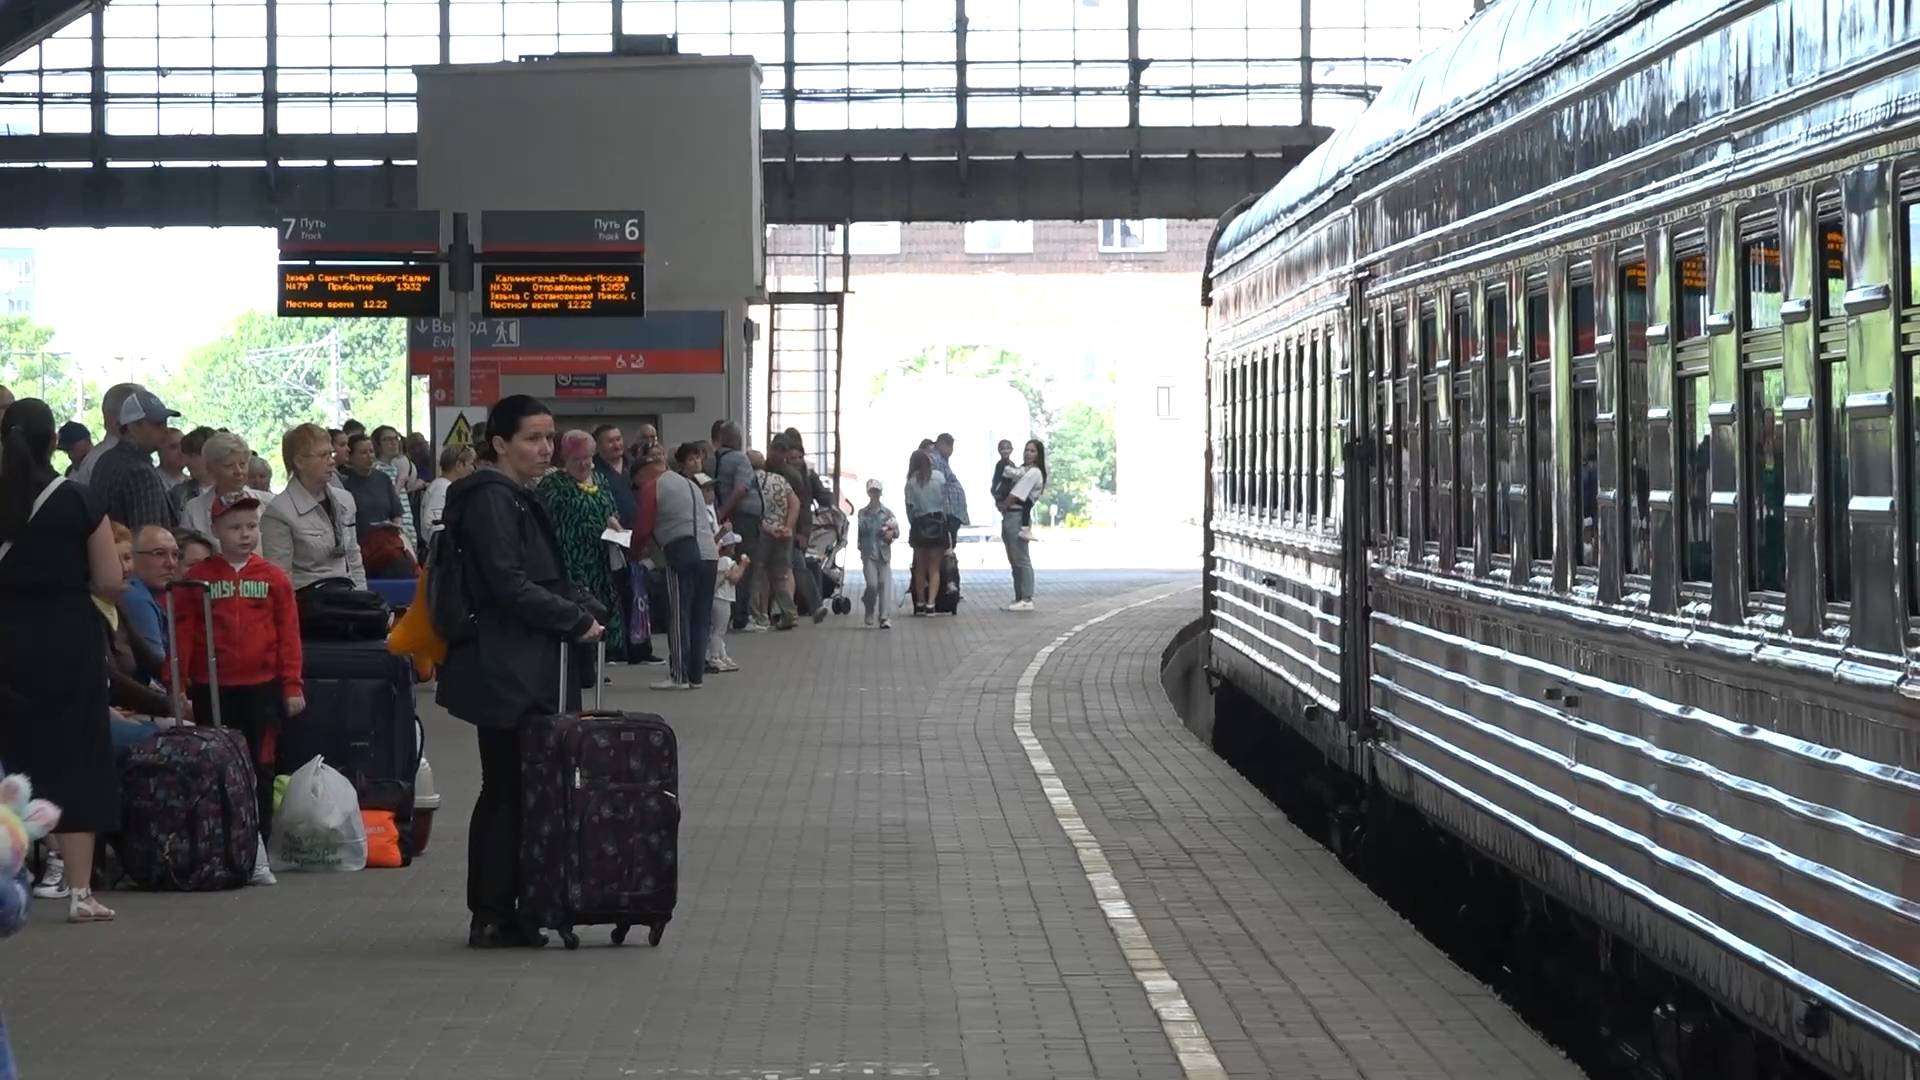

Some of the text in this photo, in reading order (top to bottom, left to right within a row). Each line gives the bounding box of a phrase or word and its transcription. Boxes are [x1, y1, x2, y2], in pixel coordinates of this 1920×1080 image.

[300, 218, 326, 230] Путь
[594, 219, 621, 231] Путь
[282, 218, 297, 240] 7
[625, 219, 639, 240] 6
[301, 231, 322, 240] Track
[598, 232, 620, 240] Track
[328, 282, 374, 291] Прибытие
[532, 283, 592, 291] Отправление
[523, 292, 530, 300] С
[286, 300, 323, 308] Местное
[327, 301, 354, 309] время
[490, 301, 528, 309] Местное
[432, 318, 488, 335] Выод
